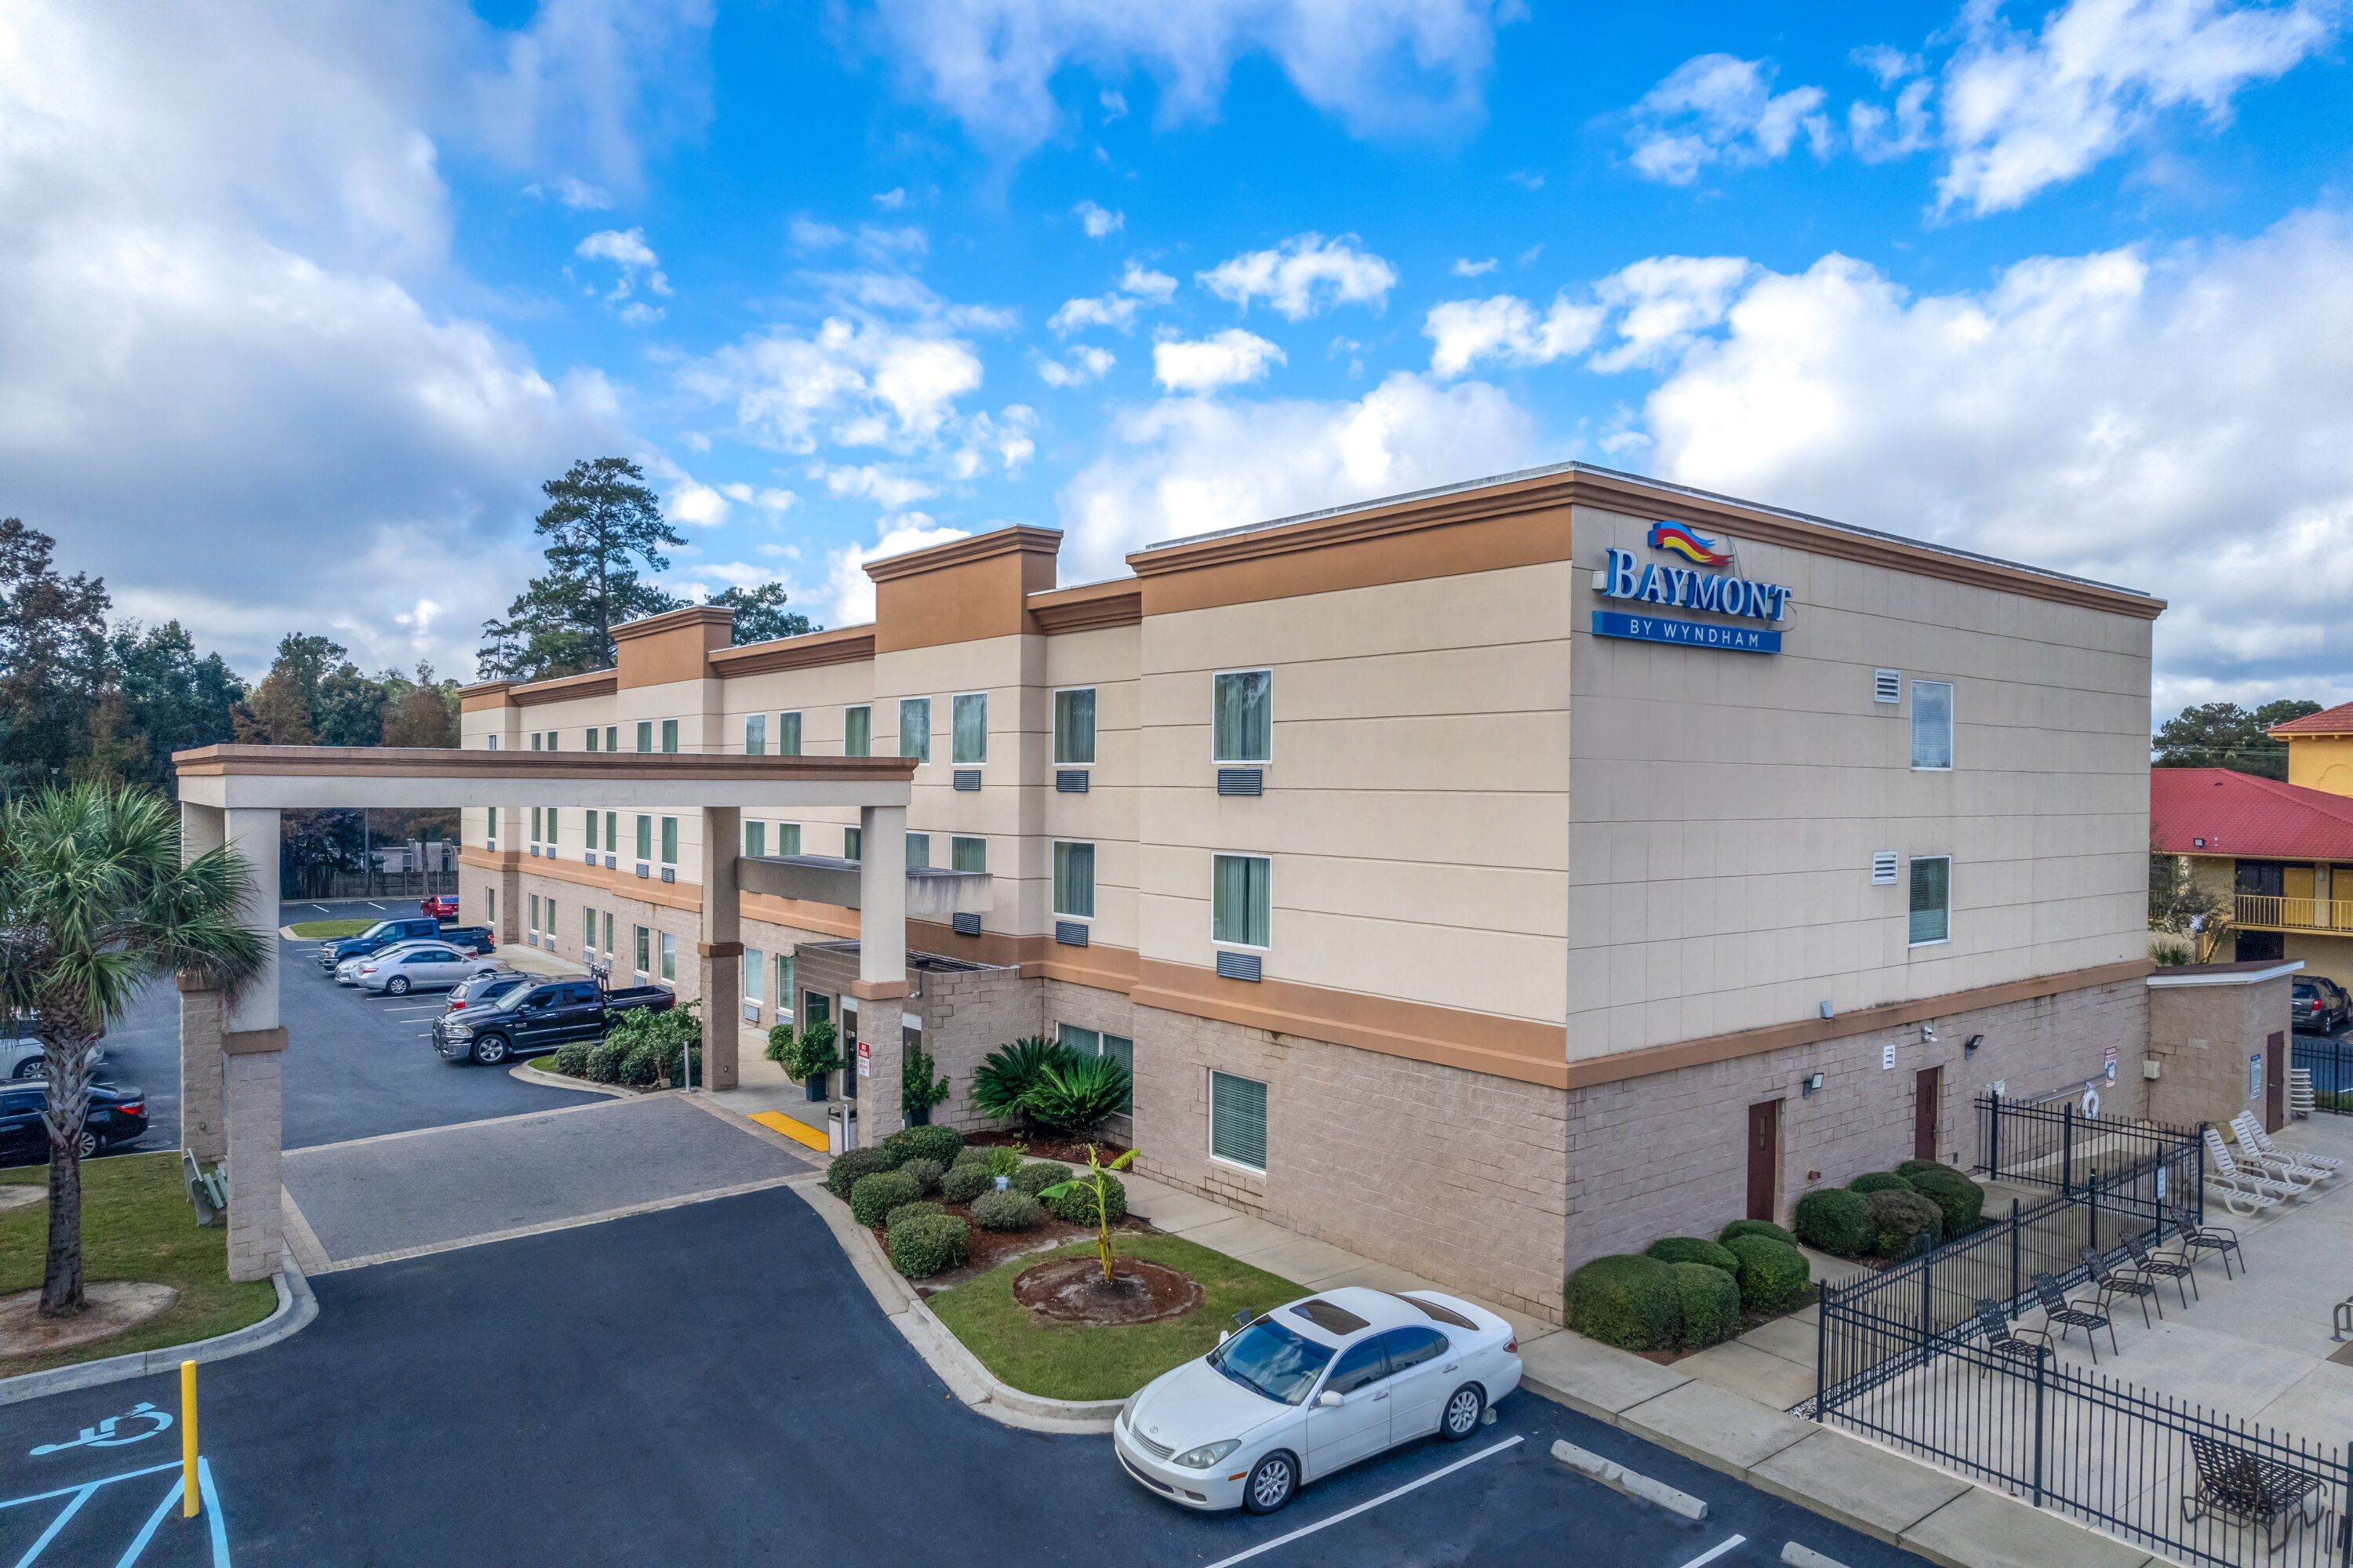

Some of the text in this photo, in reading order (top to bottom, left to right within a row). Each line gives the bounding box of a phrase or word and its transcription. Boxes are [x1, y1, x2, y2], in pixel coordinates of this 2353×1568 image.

[1602, 548, 1792, 621] BAYMONT
[1630, 619, 1758, 648] BY WYNDHAM
